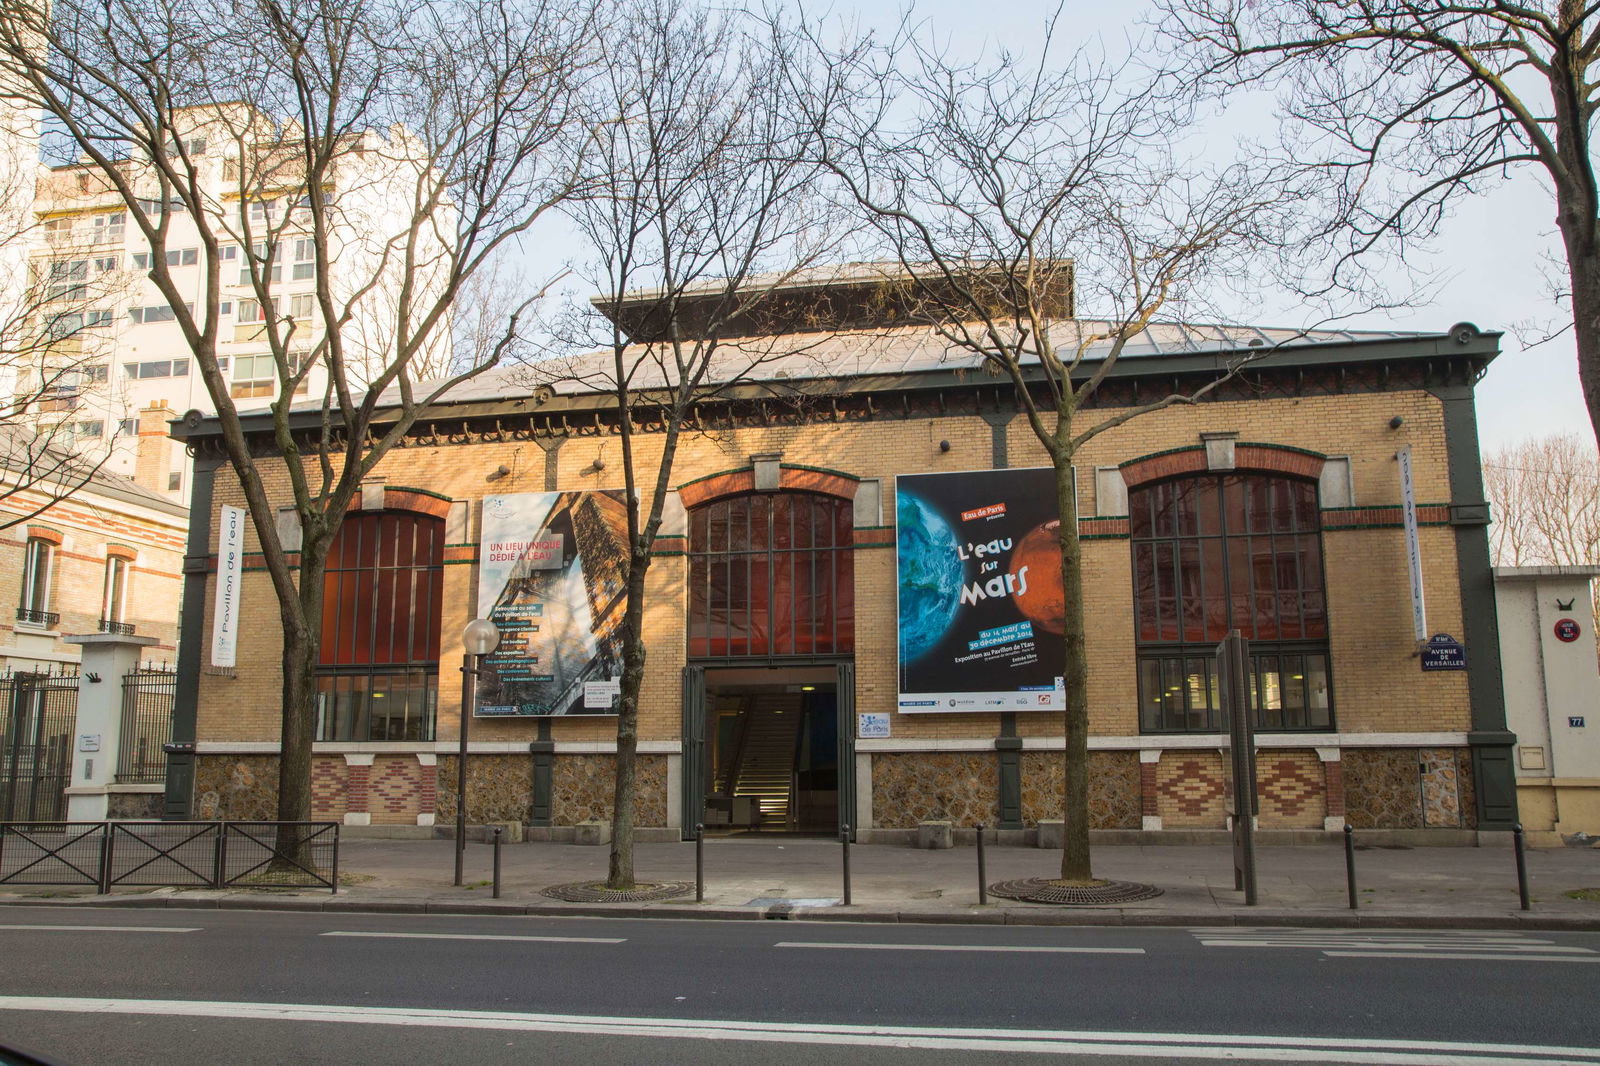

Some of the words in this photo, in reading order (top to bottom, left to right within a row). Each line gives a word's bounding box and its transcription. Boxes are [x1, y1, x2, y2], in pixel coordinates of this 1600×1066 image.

[987, 506, 1004, 514] Paris
[228, 511, 237, 546] l'eau
[490, 544, 502, 552] UN
[506, 542, 523, 550] LIEU
[526, 540, 560, 550] UNIQUE
[958, 538, 1012, 560] L'eau
[227, 552, 235, 570] de
[490, 550, 516, 562] DÉDIÉ
[528, 552, 552, 560] L'EAU
[980, 560, 998, 574] sur
[960, 565, 1028, 606] Mars
[222, 576, 233, 633] Pavillon
[954, 653, 982, 663] Exposition
[991, 646, 1013, 655] Pavillon
